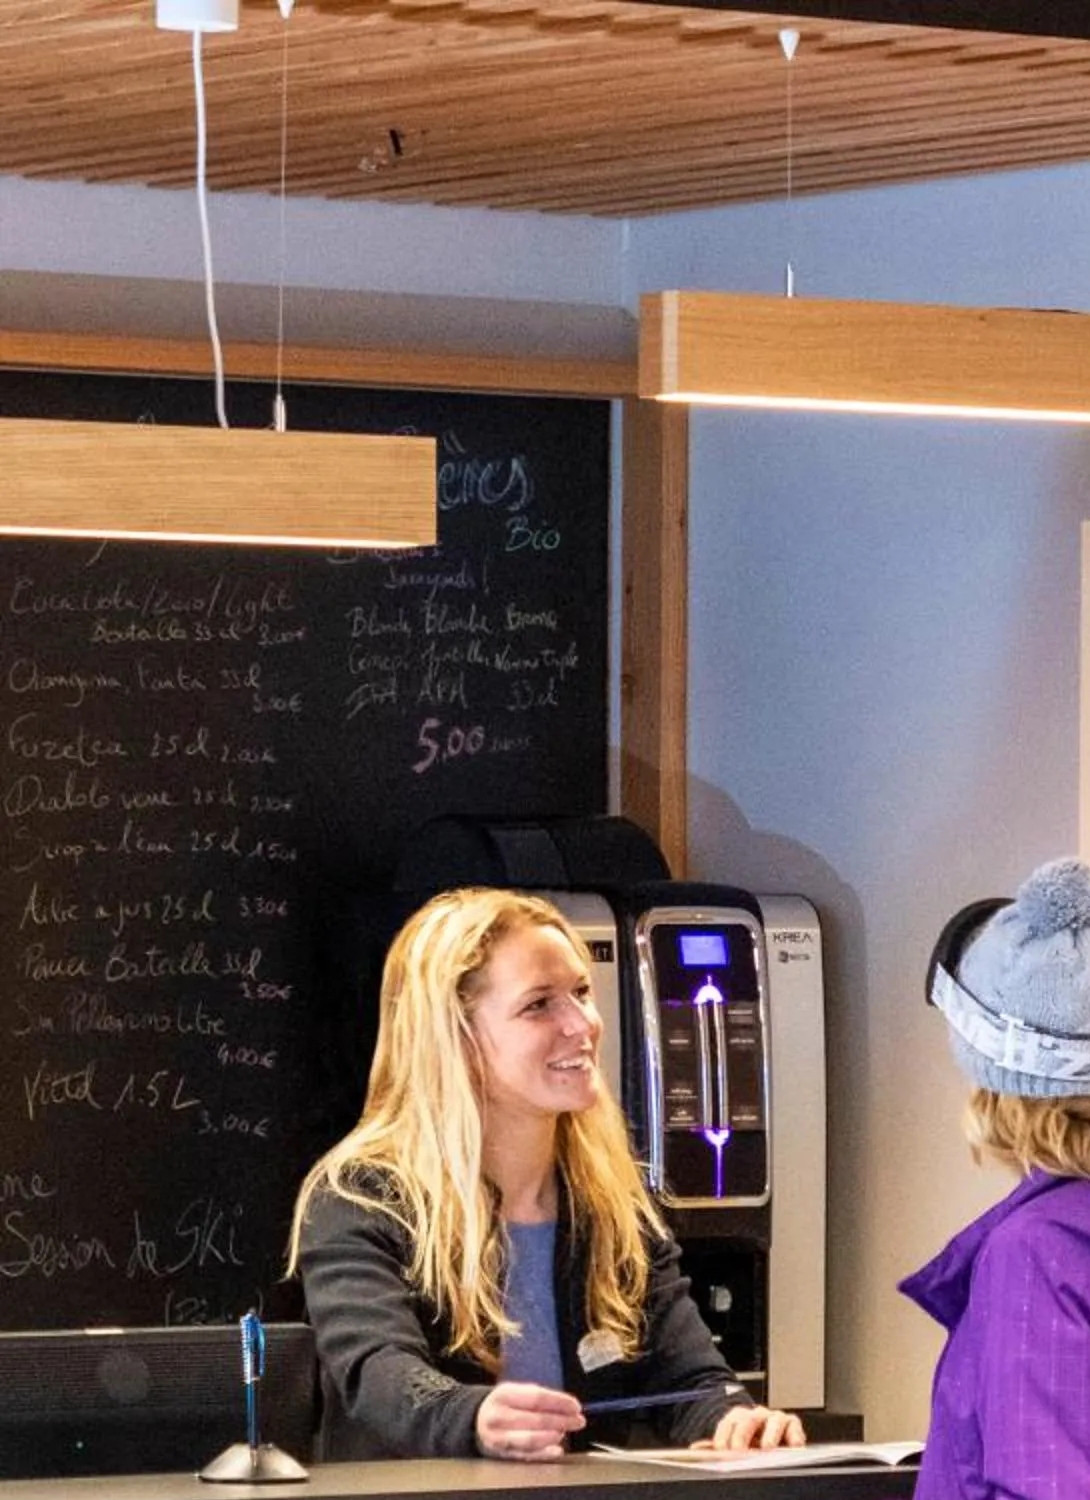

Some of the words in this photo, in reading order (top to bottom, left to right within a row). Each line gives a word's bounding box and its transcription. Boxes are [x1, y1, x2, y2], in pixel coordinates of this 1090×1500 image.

[505, 513, 561, 552] Bio
[4, 772, 111, 817] Diabolo
[0, 1210, 116, 1277] Session
